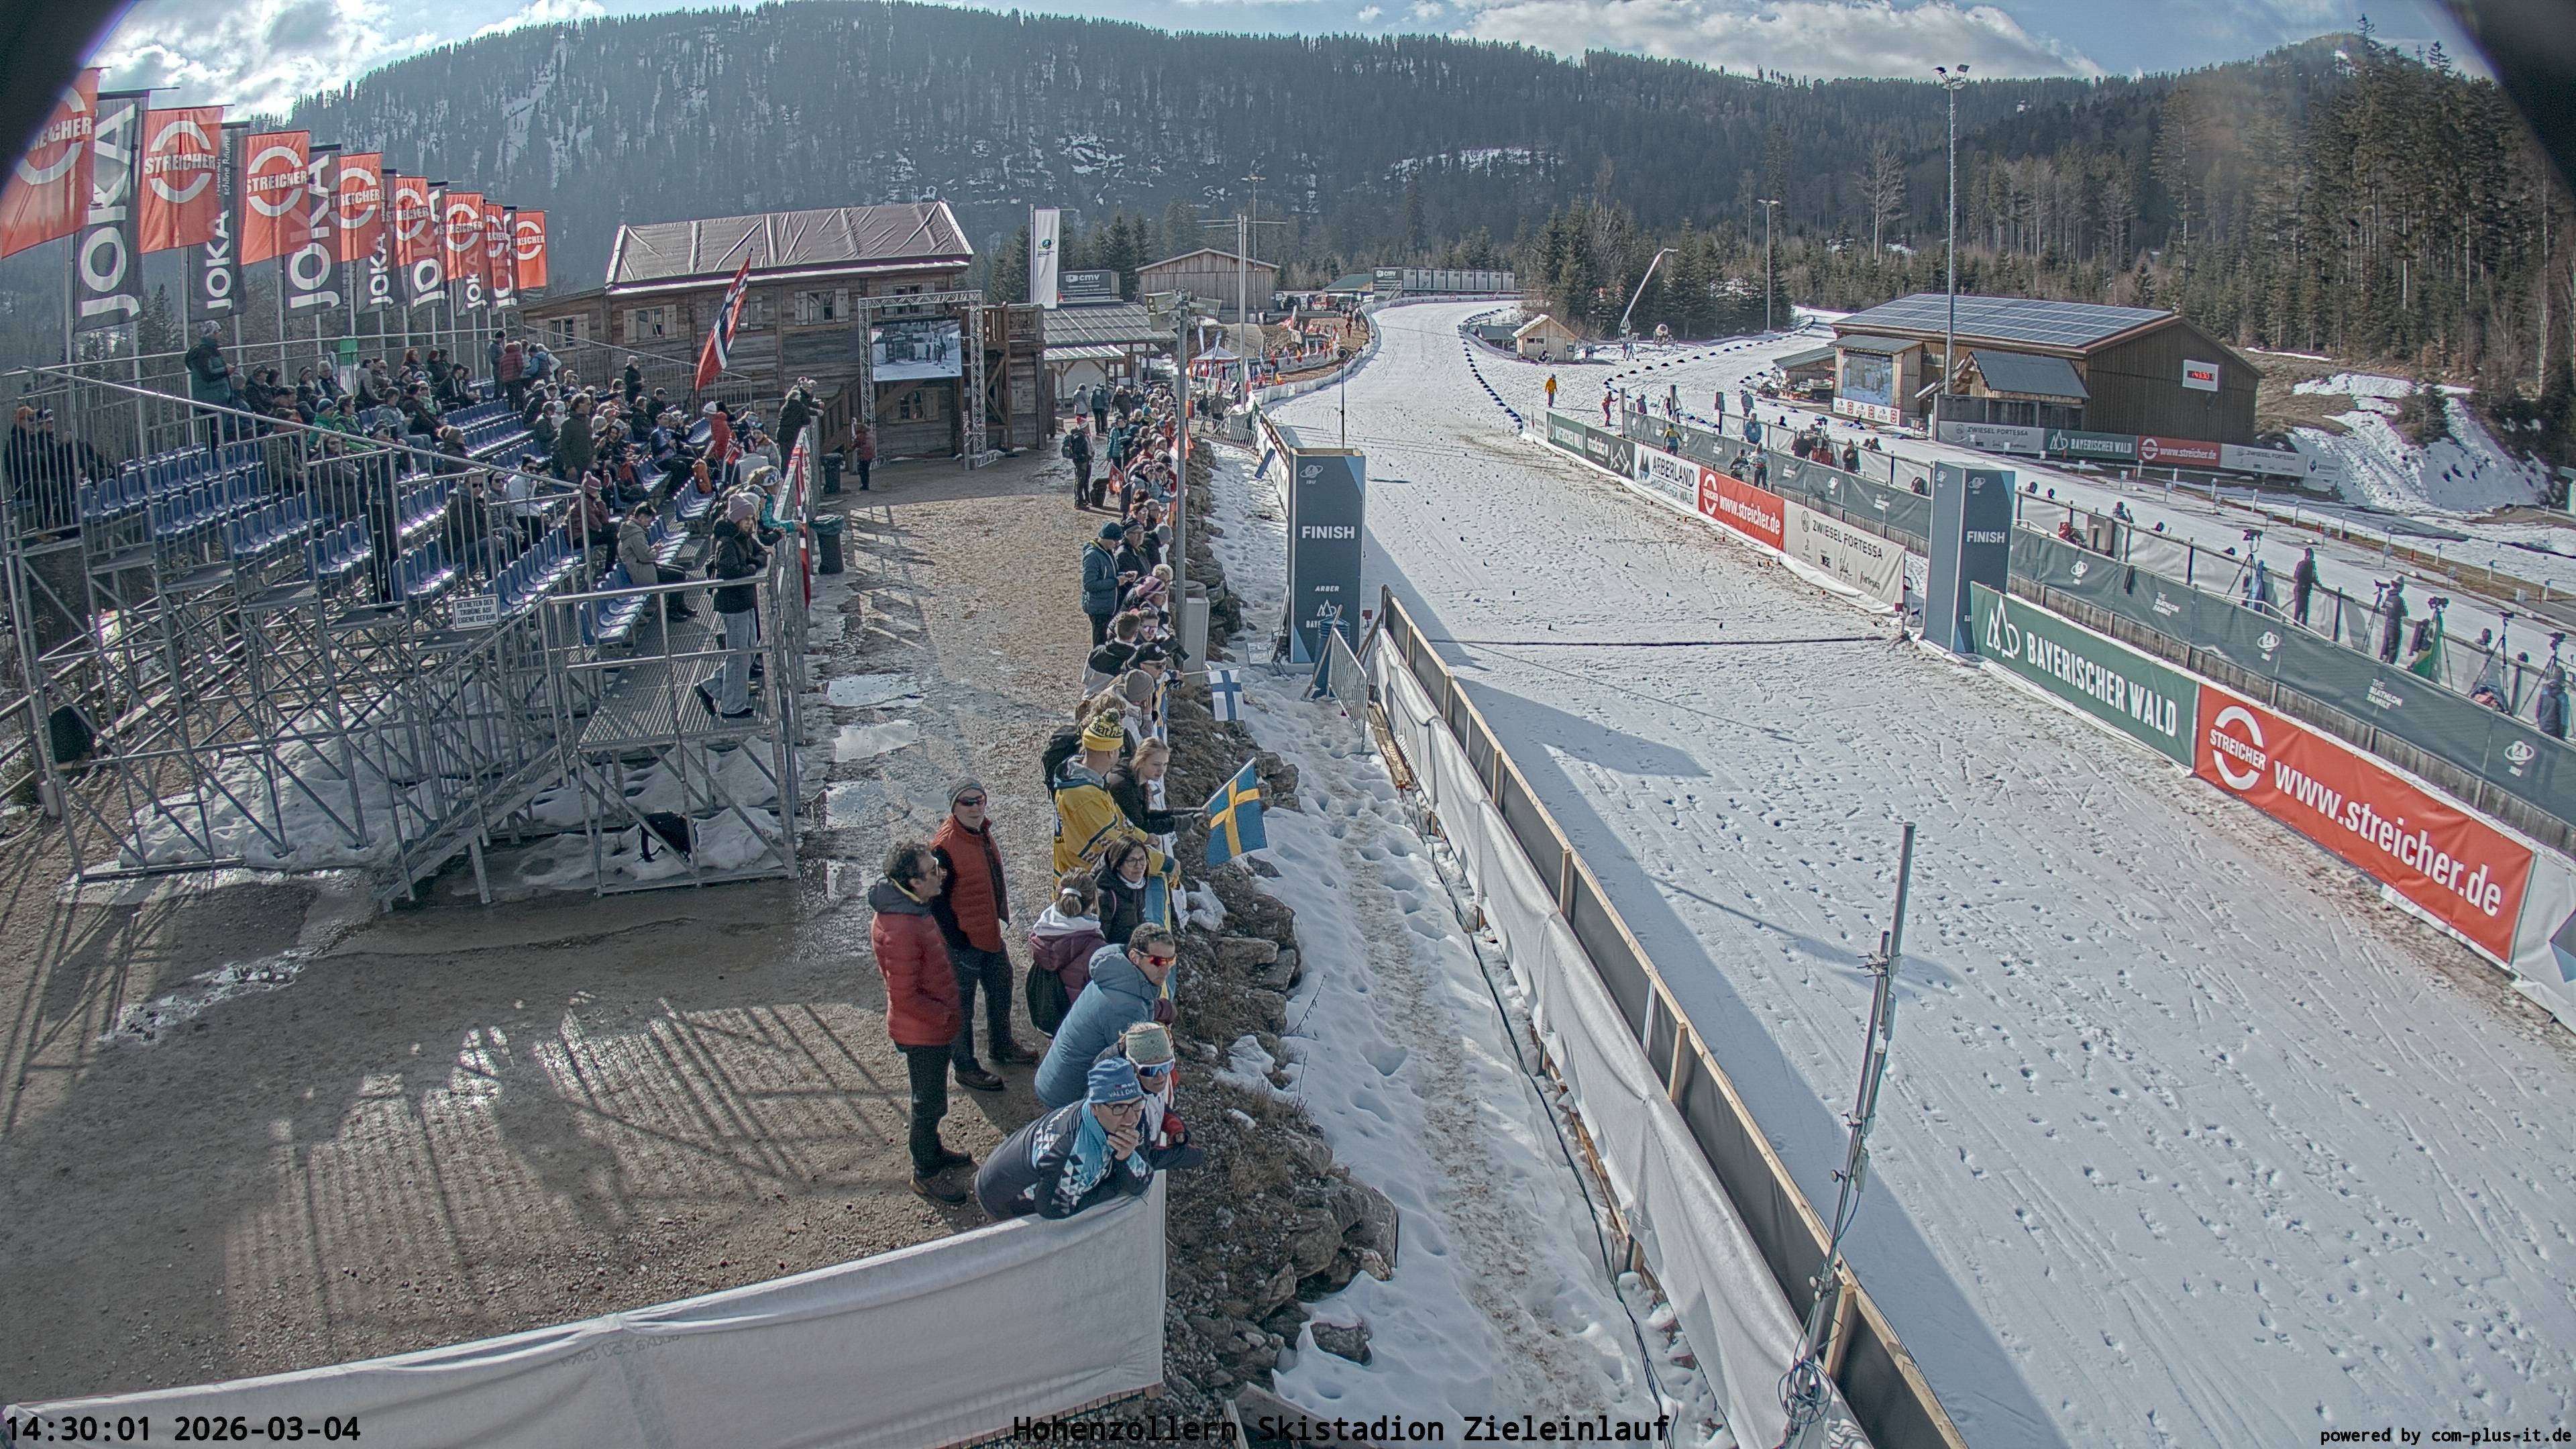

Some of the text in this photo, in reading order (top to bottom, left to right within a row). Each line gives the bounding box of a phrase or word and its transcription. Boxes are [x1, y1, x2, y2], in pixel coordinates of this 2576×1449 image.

[144, 153, 216, 174] STREICHER
[246, 170, 307, 194] STREICHER
[80, 103, 140, 317] JOKA
[290, 154, 339, 309] JOKA
[206, 209, 232, 310] JOKA
[370, 232, 393, 305] JOKA
[1967, 426, 2028, 436] ZWIESEL FORTESSA
[2070, 437, 2132, 453] BAYERISCHER WALD
[2159, 447, 2216, 460] www.streicher.de
[1652, 455, 1695, 488] ARBERLAND
[1719, 495, 1780, 535] www.streicher.de
[1301, 525, 1355, 539] FINISH
[1813, 520, 1842, 543] ZWIESEL
[1844, 533, 1884, 561] FORTESSA
[1966, 531, 2005, 543] FINISH
[2026, 631, 2177, 737] BAYERISCHER WALD
[2368, 686, 2403, 707] BIATHLON
[2372, 678, 2385, 690] THE
[2365, 693, 2392, 710] FAMILY
[2210, 729, 2267, 771] STREICHER
[2273, 759, 2502, 917] www.streicher.de
